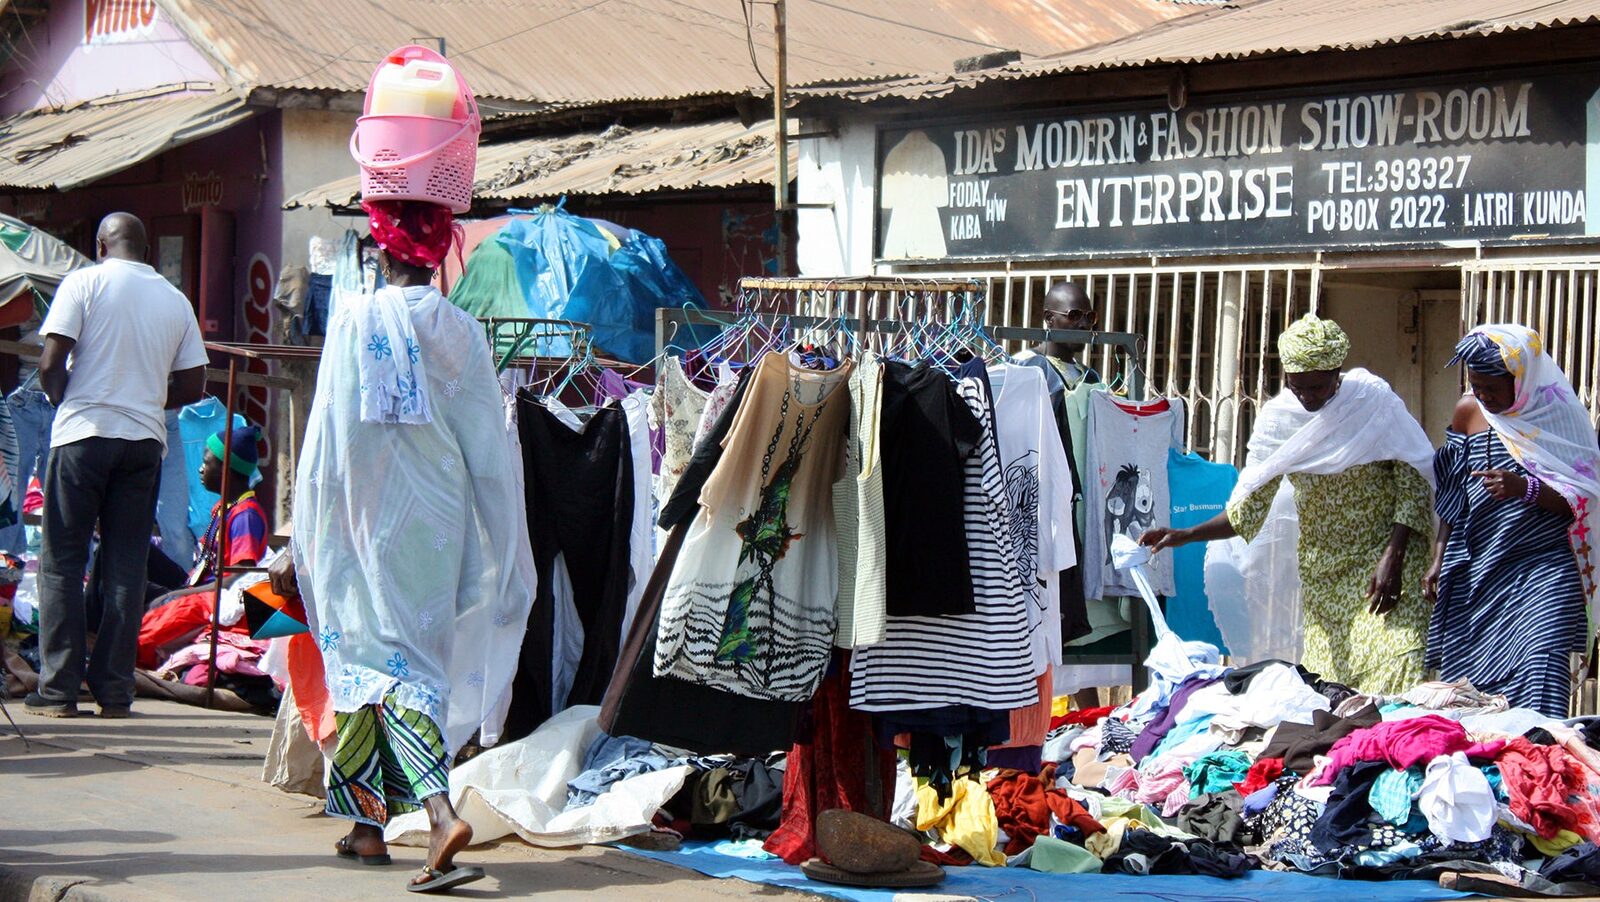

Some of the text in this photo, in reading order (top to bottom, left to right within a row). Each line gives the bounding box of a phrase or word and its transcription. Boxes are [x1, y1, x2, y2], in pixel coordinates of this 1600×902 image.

[1015, 115, 1136, 170] MODERN
[1138, 122, 1148, 146] &
[1150, 103, 1286, 162] FASHION
[1299, 83, 1533, 151] SHOW-ROOM
[949, 180, 990, 208] FODAY
[1321, 155, 1472, 195] TEL:393327
[1055, 166, 1293, 229] ENTERPRISE
[1389, 193, 1448, 230] 2022
[1463, 193, 1515, 227] LATRI
[1522, 189, 1588, 226] KUNDA
[950, 214, 983, 241] KABA
